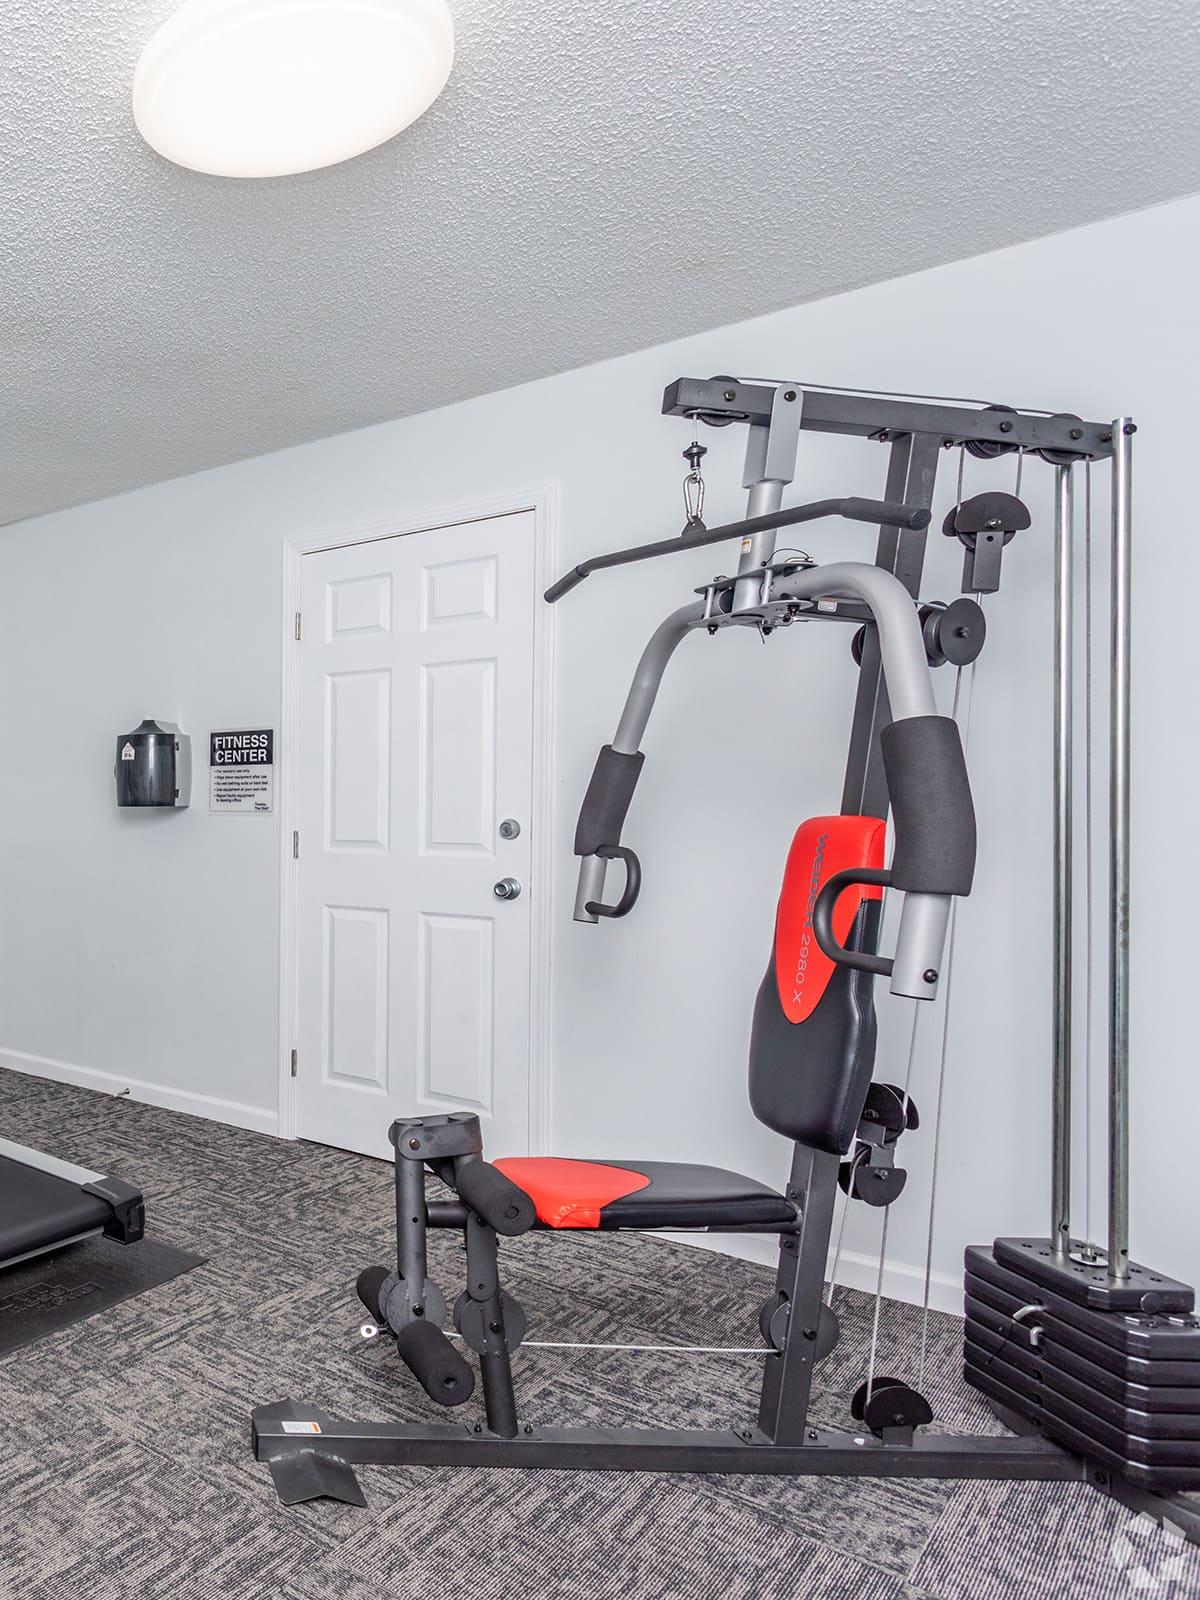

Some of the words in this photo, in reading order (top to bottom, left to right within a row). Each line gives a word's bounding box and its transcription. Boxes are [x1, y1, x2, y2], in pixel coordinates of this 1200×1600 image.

[215, 735, 268, 749] FITNESS
[215, 749, 268, 763] CENTER
[796, 934, 811, 985] 2980
[792, 990, 804, 1005] X
